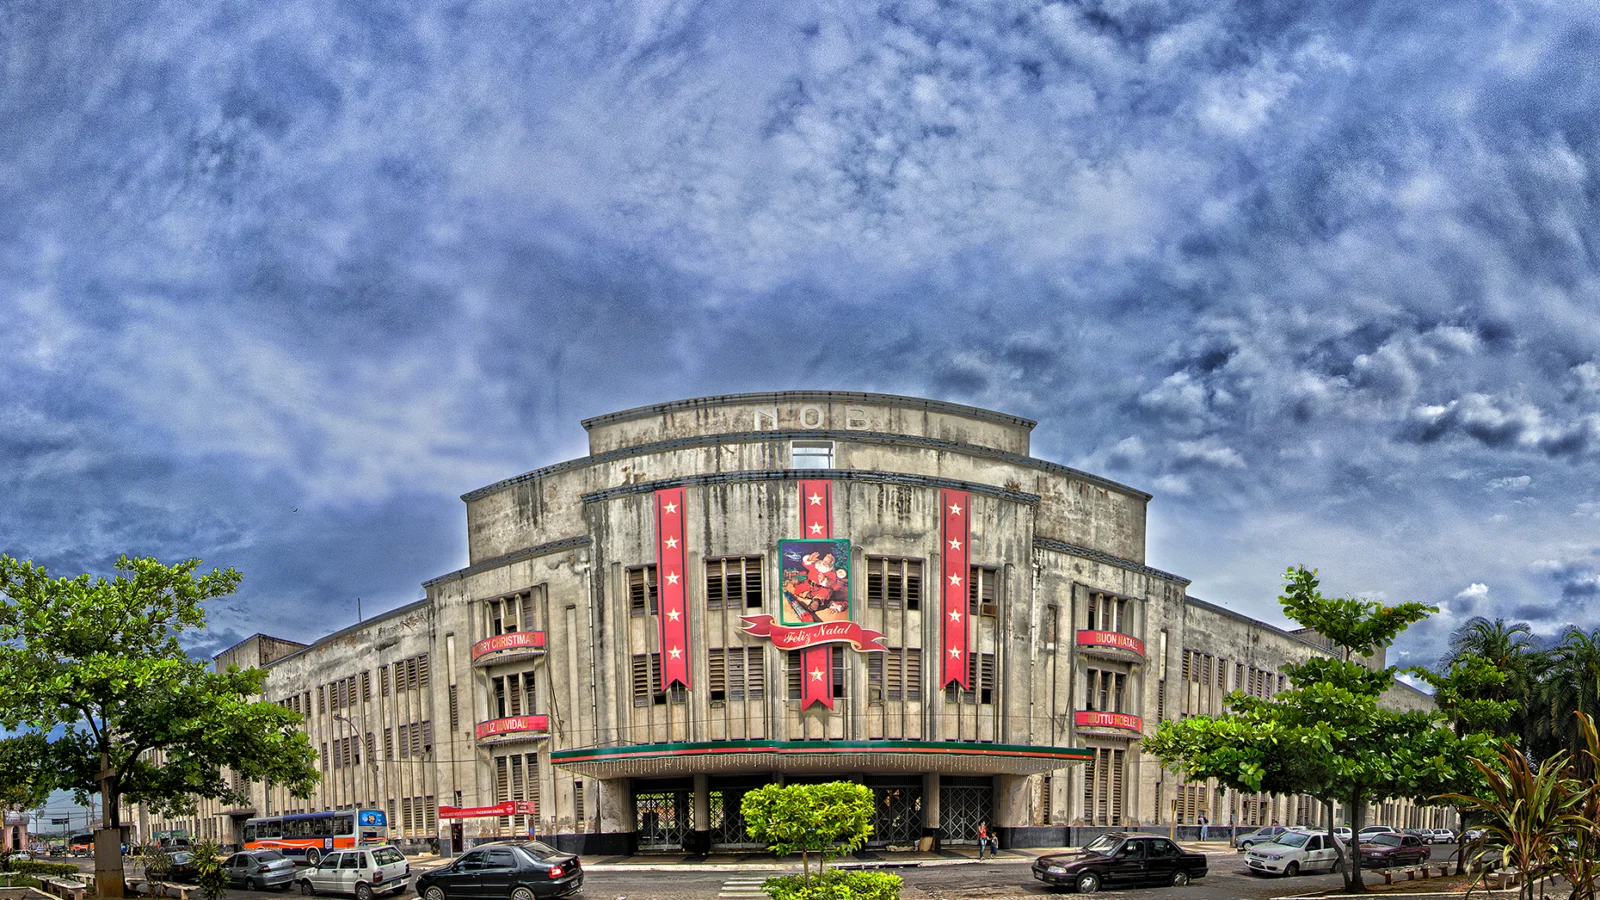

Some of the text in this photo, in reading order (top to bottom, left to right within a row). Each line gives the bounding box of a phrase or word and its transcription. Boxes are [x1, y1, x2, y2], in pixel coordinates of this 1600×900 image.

[754, 405, 872, 431] NOB
[491, 634, 536, 649] CHRISTIMAS
[783, 623, 852, 645] Feliz Natal
[1096, 633, 1138, 650] BUON NATALE
[496, 717, 528, 732] NAVIDAD
